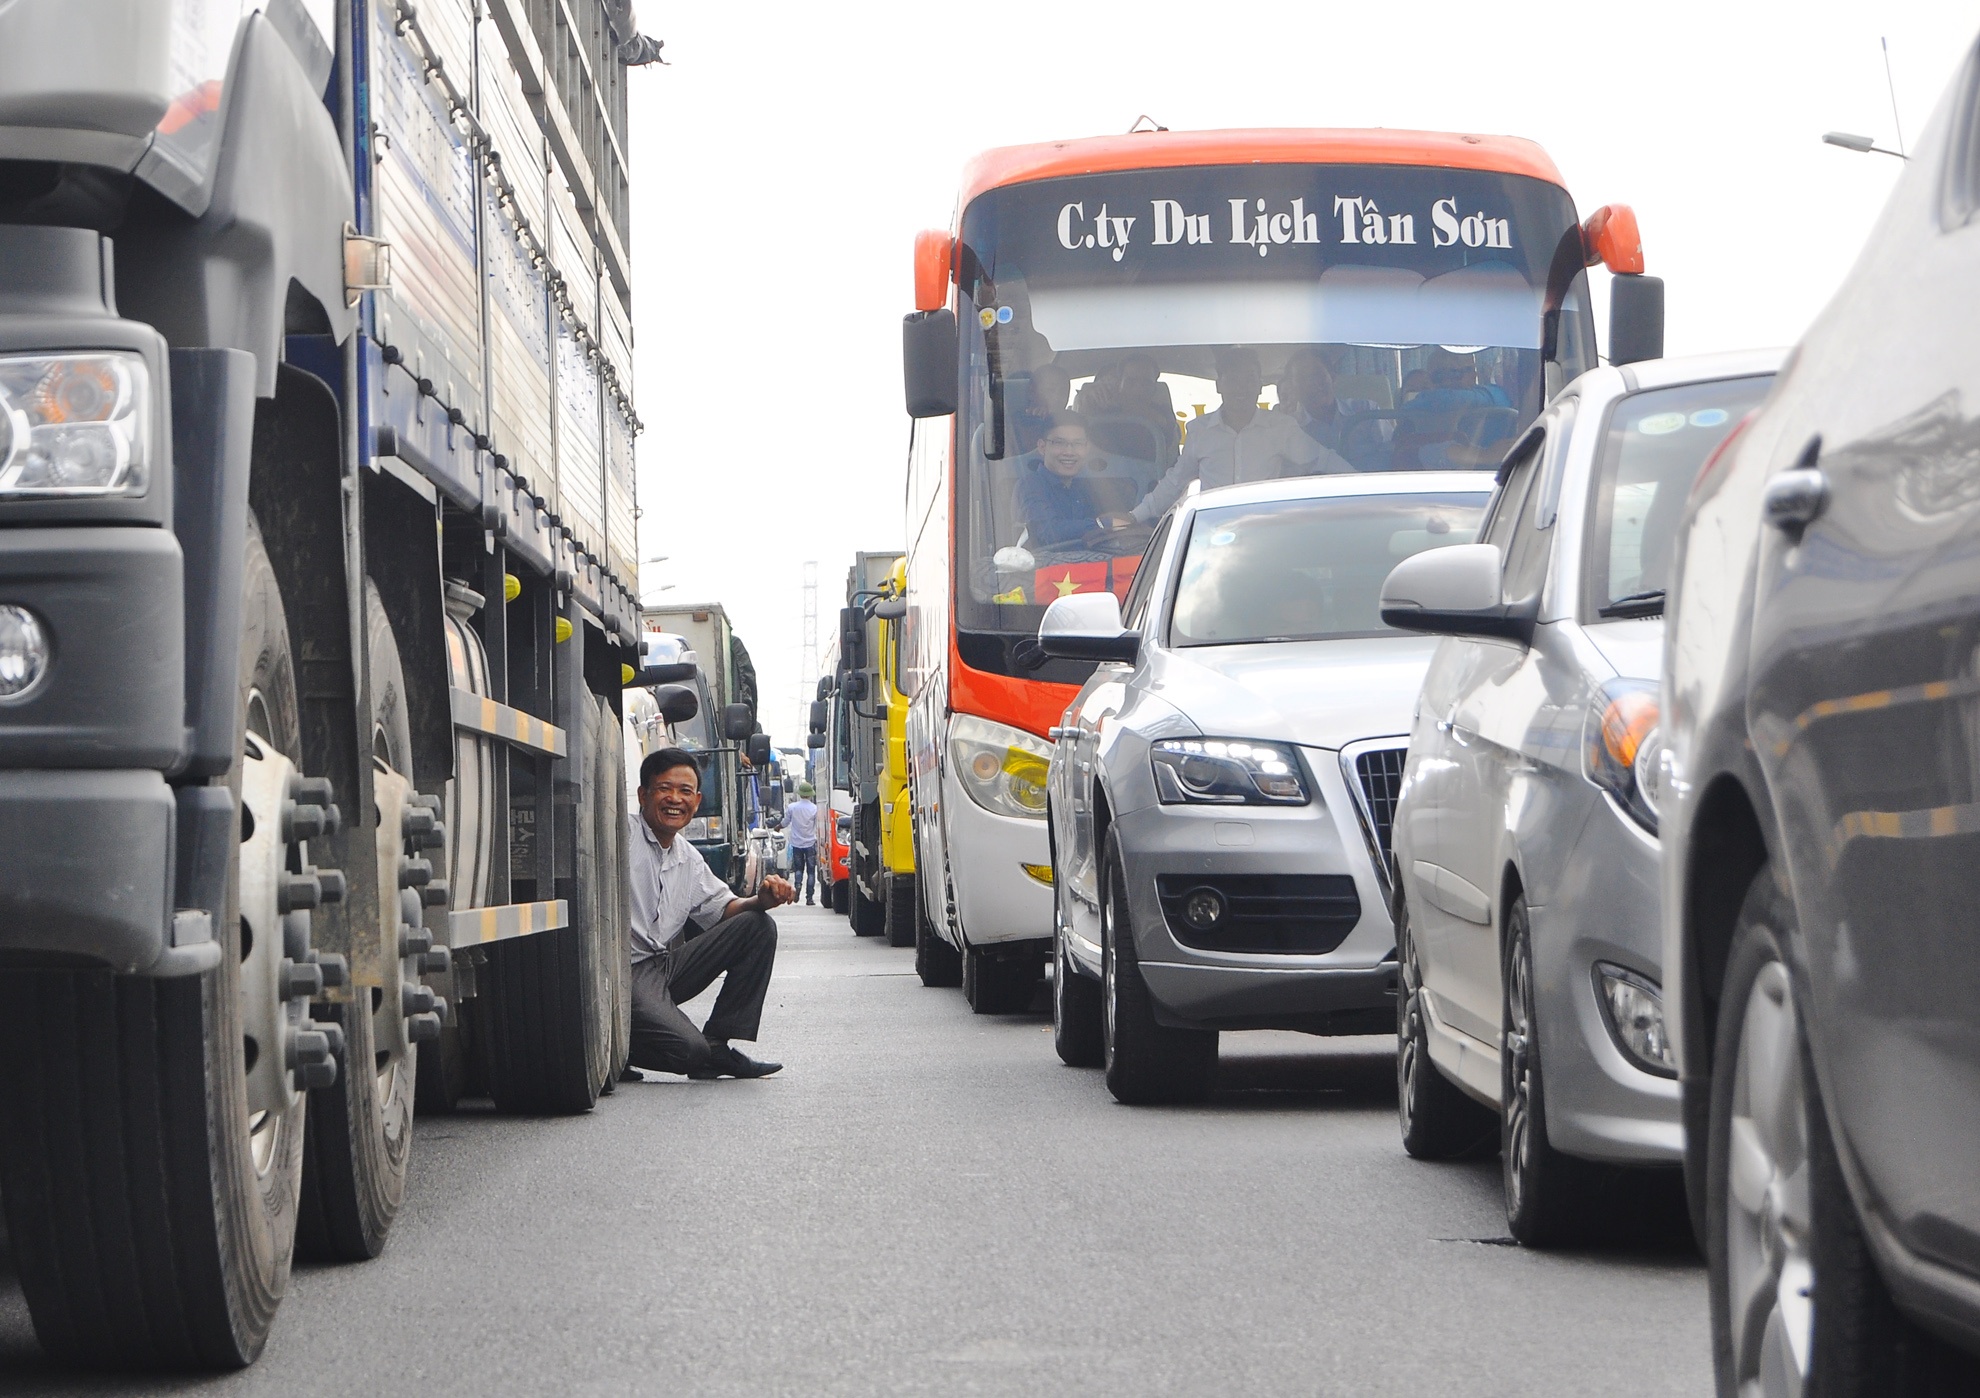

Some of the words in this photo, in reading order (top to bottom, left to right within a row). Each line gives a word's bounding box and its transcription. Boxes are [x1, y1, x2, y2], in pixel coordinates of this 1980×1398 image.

[1057, 200, 1137, 262] C.ty
[1150, 199, 1214, 246] Du
[1227, 197, 1321, 258] Lịch
[1334, 194, 1418, 245] Tân
[1431, 196, 1513, 249] Sơn
